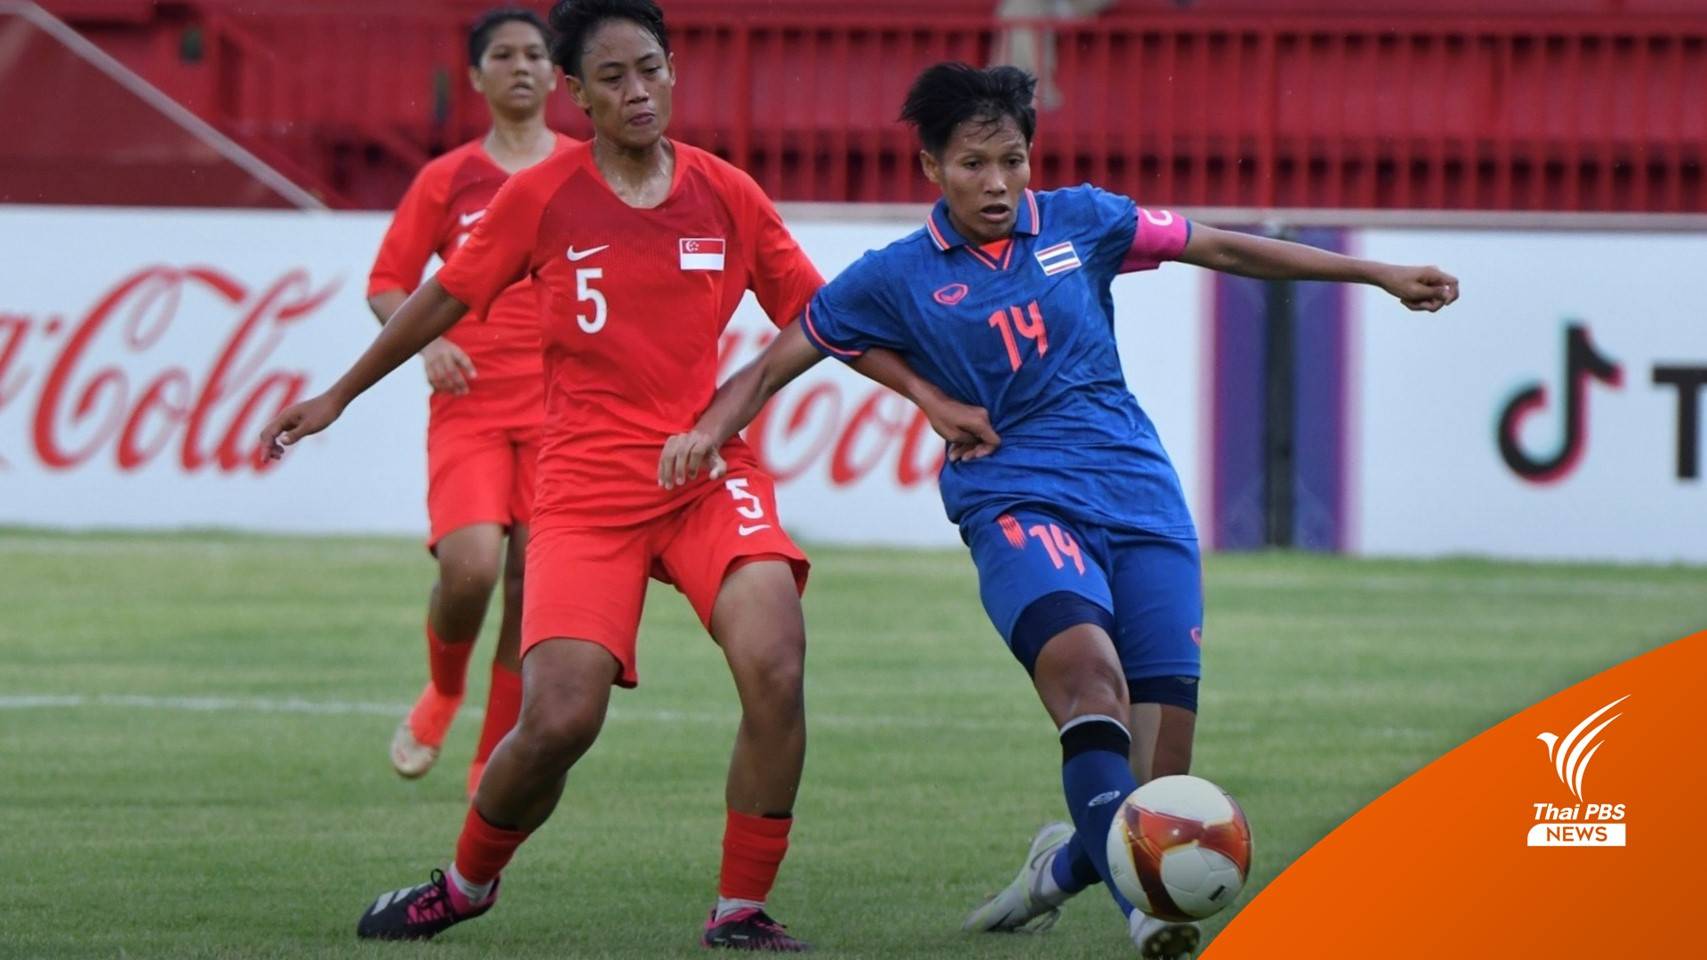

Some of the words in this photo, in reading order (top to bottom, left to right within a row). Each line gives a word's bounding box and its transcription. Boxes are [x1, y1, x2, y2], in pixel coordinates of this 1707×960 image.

[574, 267, 608, 334] 5
[988, 299, 1049, 372] 14
[1651, 363, 1707, 483] T
[725, 478, 763, 519] 5
[1028, 523, 1086, 576] 14
